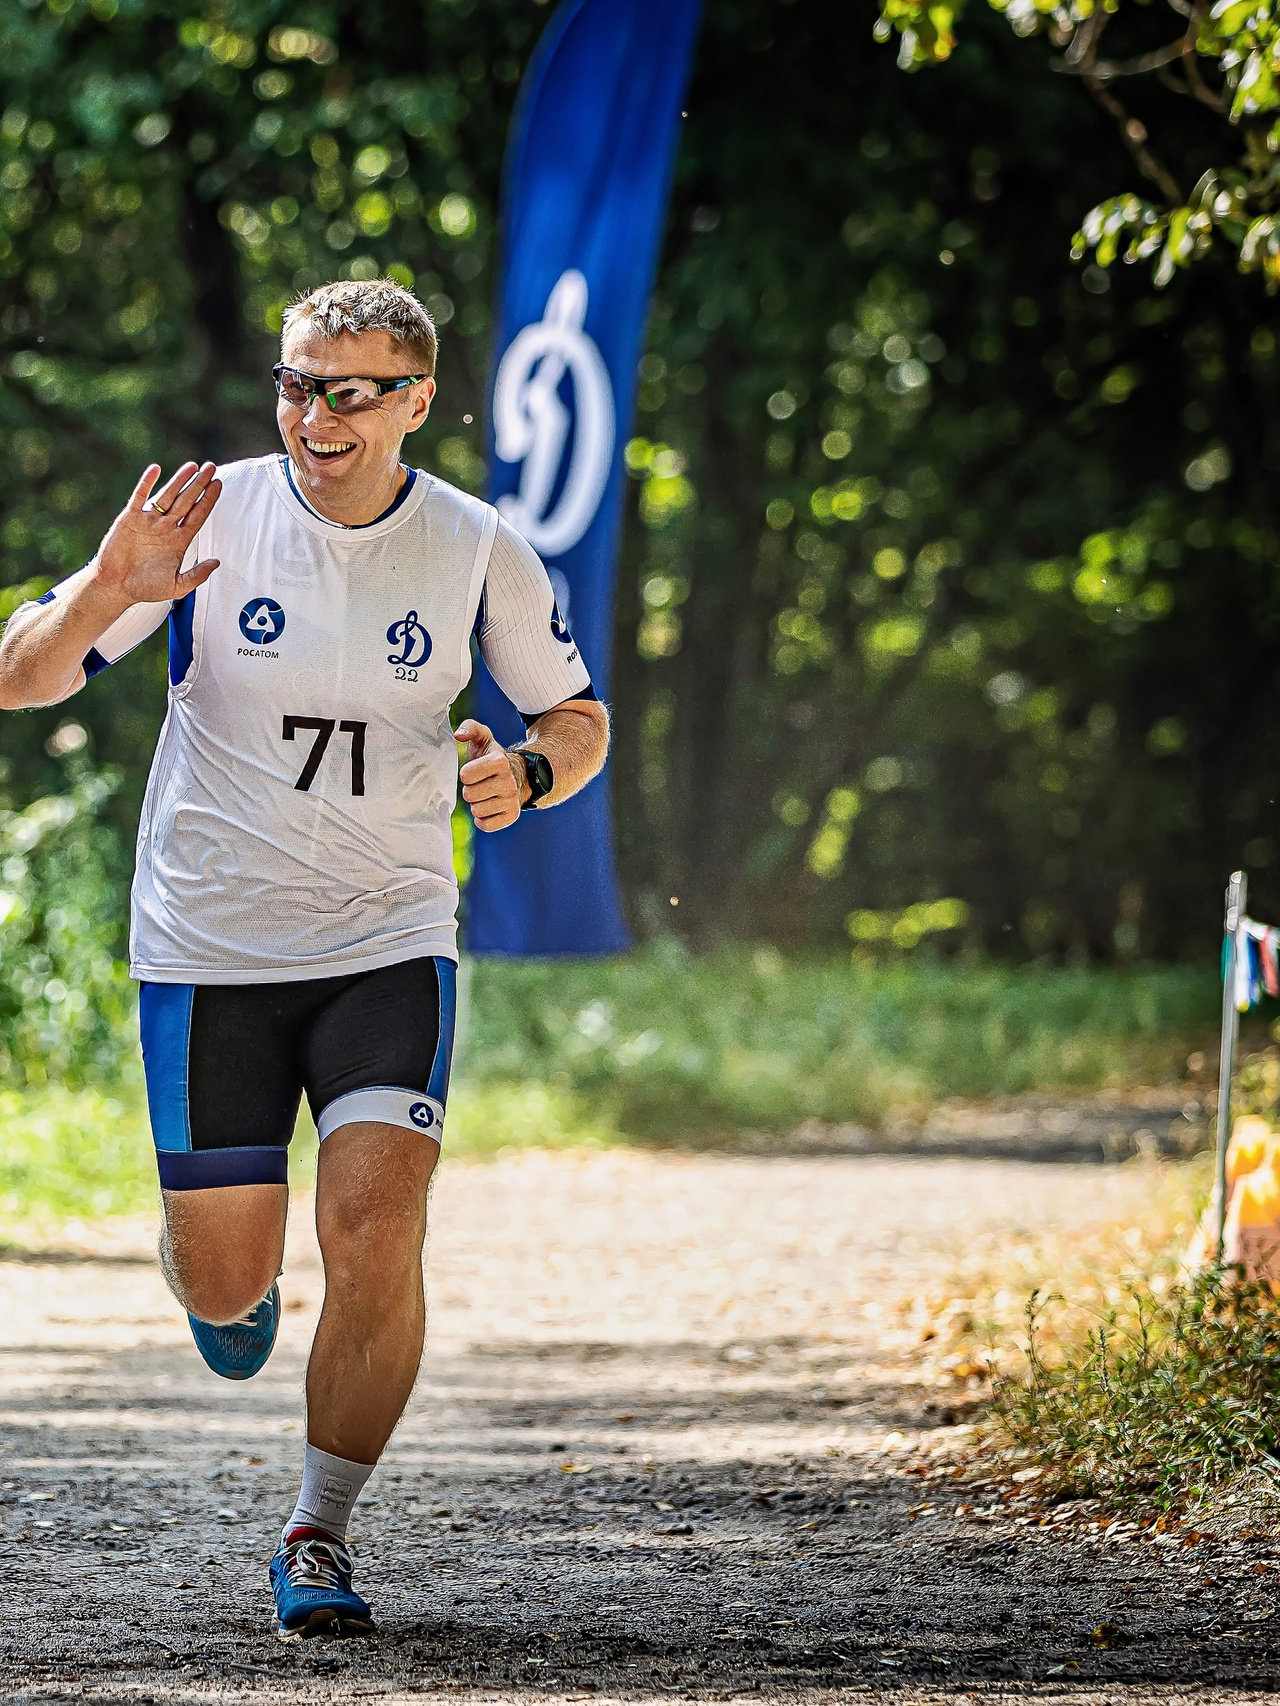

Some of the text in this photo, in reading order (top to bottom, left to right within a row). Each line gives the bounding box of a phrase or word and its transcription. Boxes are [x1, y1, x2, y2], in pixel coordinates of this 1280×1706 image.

[237, 648, 279, 659] РОСАТОМ
[566, 648, 578, 664] ROS
[394, 667, 419, 683] 22
[282, 715, 367, 797] 71
